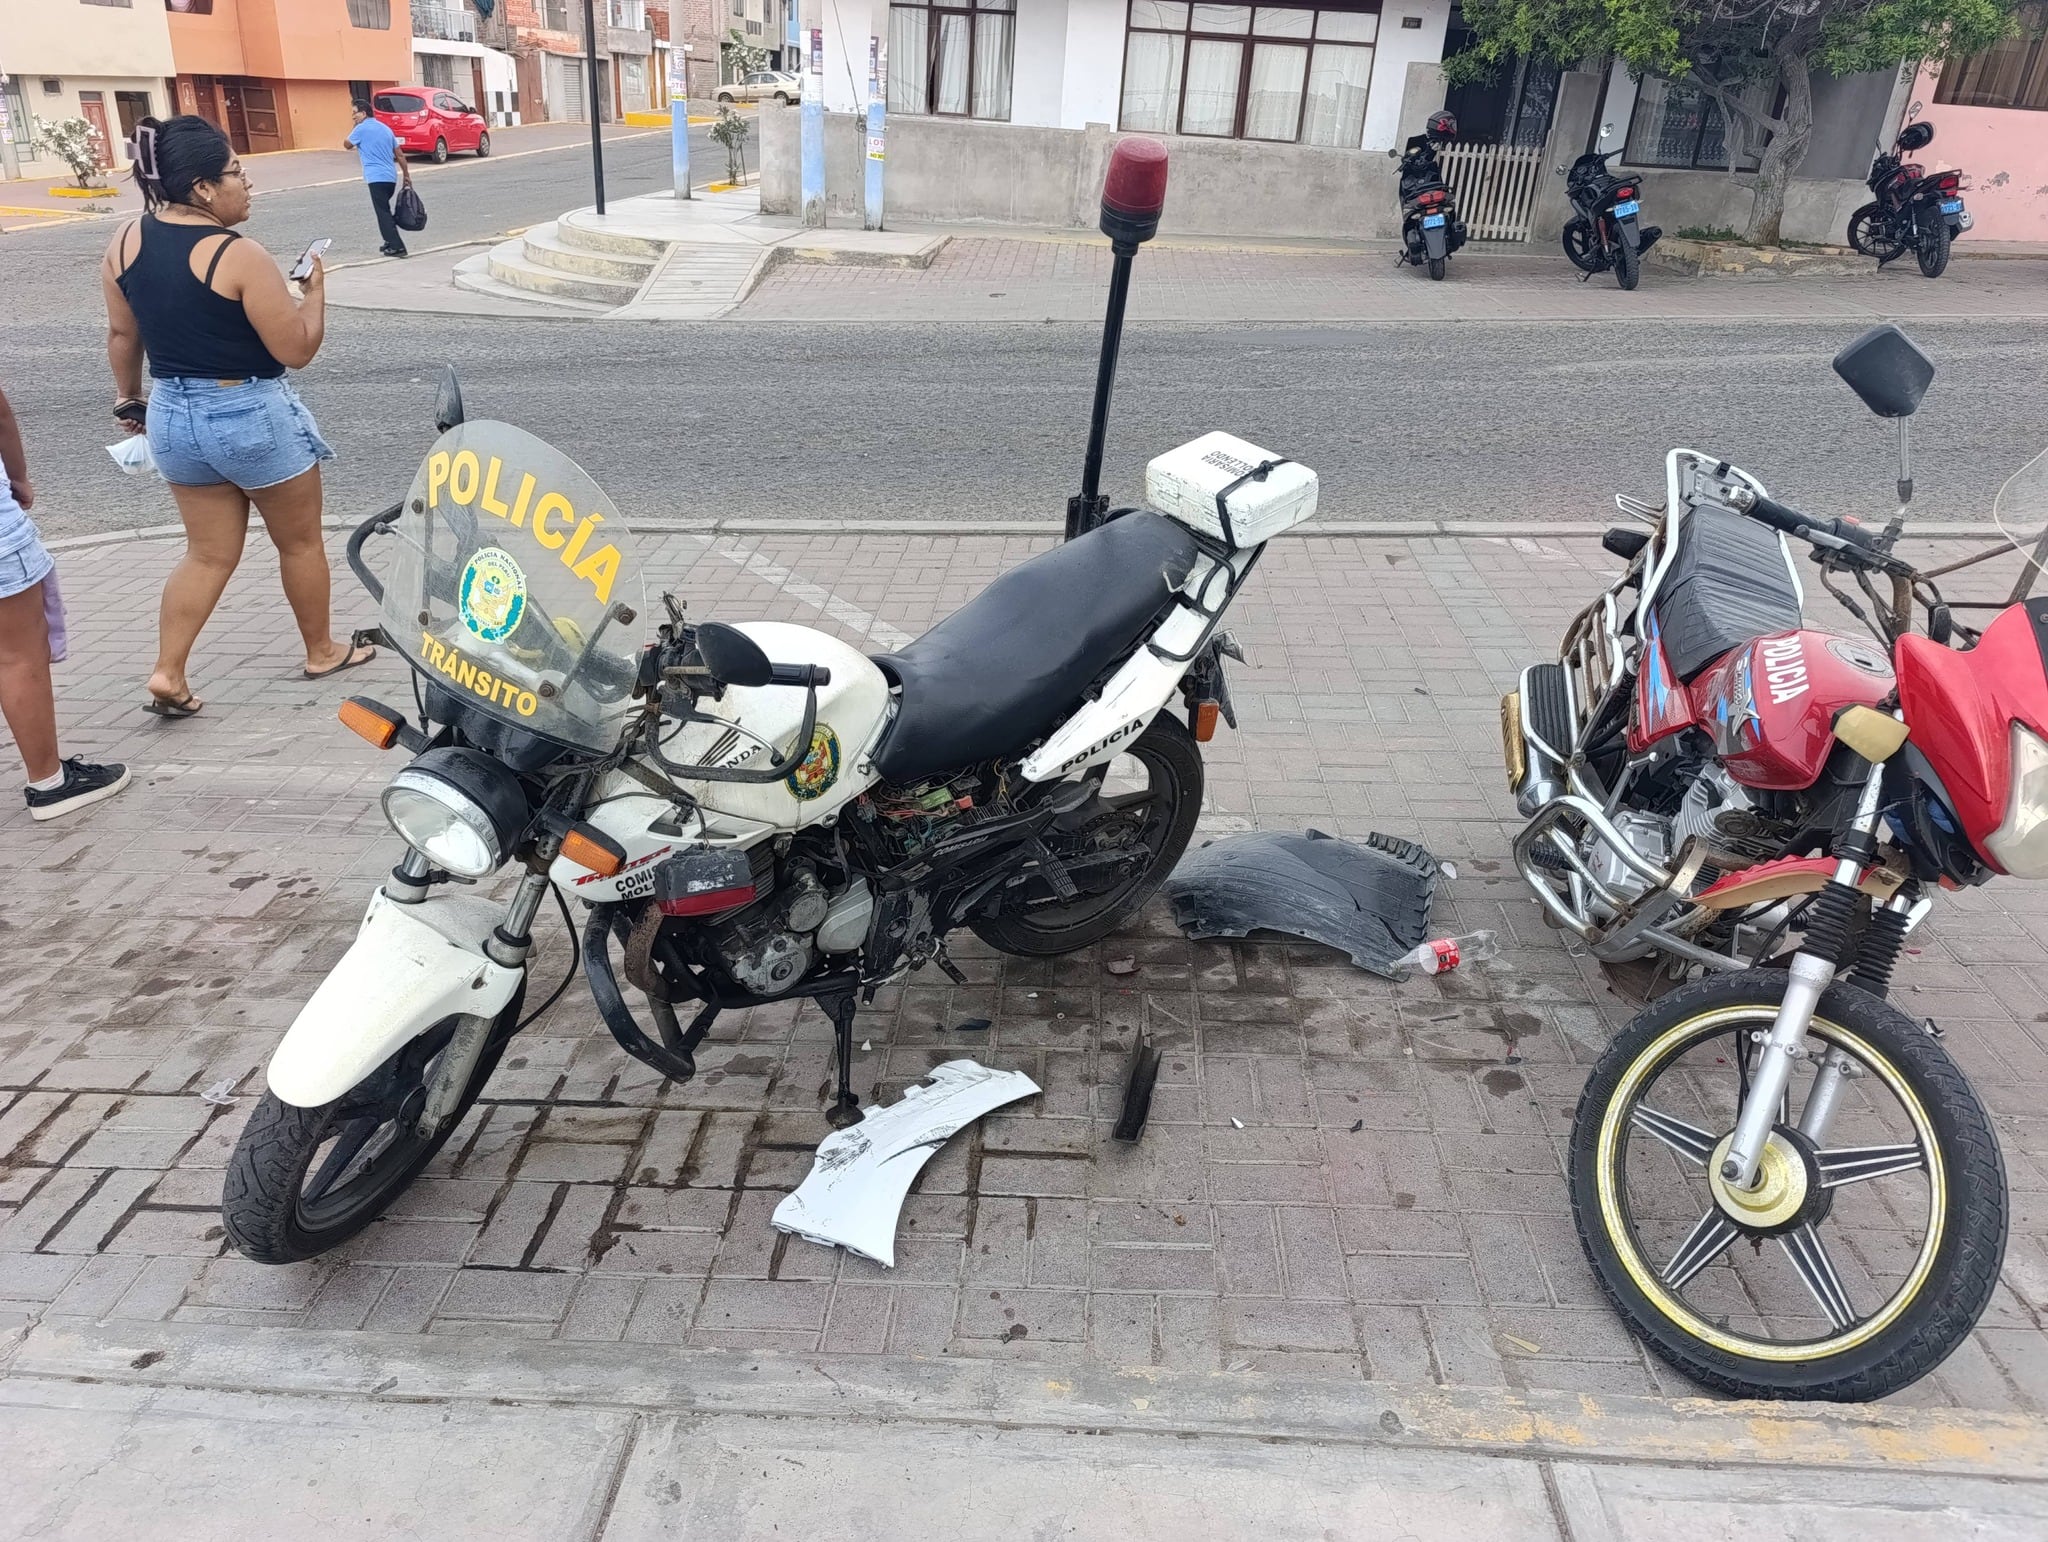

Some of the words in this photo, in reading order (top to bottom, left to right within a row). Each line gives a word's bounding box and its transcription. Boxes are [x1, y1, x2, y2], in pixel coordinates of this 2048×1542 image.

[869, 138, 886, 146] LOT
[1201, 454, 1246, 476] OMISARIA
[1210, 450, 1255, 470] OLLENDO
[428, 450, 622, 606] POLICÍA
[500, 554, 523, 590] NACIONAL
[420, 631, 538, 717] TRÁNSITO
[1762, 635, 1810, 705] POLICIA
[720, 744, 762, 769] NDA
[1061, 719, 1144, 773] POLICIA
[621, 881, 656, 900] MOL
